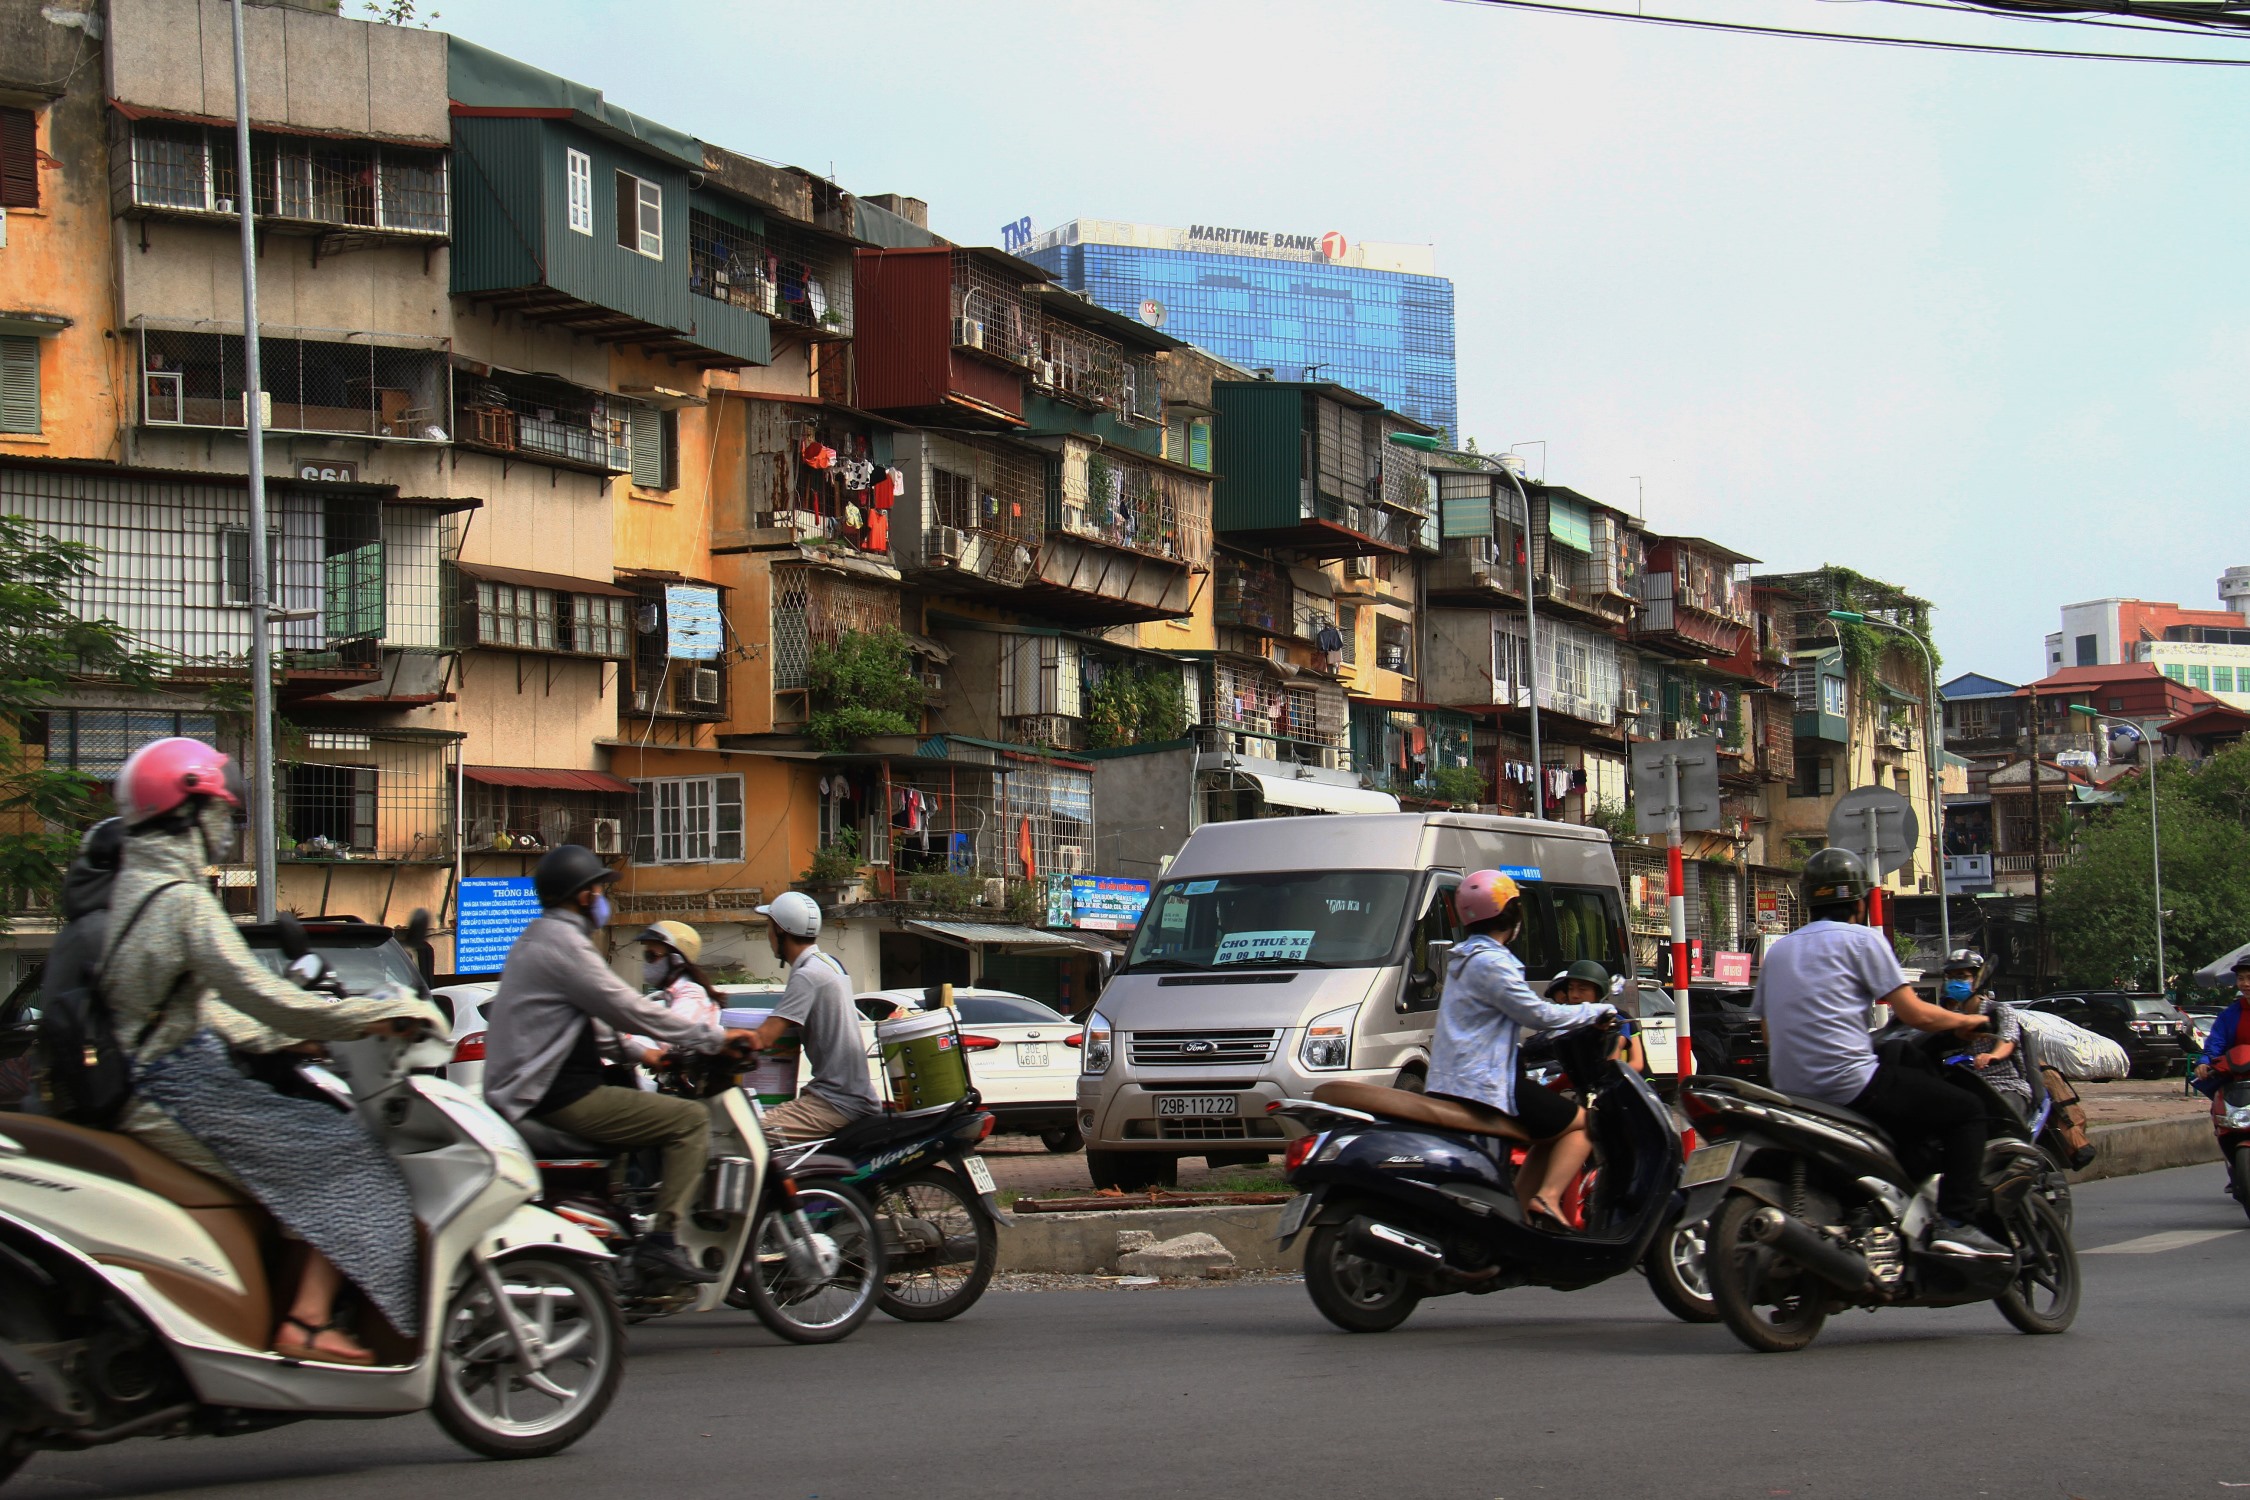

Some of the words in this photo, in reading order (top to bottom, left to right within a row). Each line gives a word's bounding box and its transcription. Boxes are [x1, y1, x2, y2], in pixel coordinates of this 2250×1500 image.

[1001, 216, 1032, 252] TNR
[1188, 224, 1269, 246] MARITIME
[1274, 233, 1318, 251] BANK
[493, 887, 522, 897] THÔNG
[1222, 939, 1248, 949] CHO
[1252, 936, 1288, 946] THUÊ
[1290, 938, 1310, 946] XE
[1025, 1044, 1040, 1053] 30E
[1186, 1043, 1207, 1051] Ford
[1020, 1055, 1048, 1065] 460.18
[1161, 1098, 1233, 1114] 29B-112.22
[870, 1144, 918, 1172] Wave
